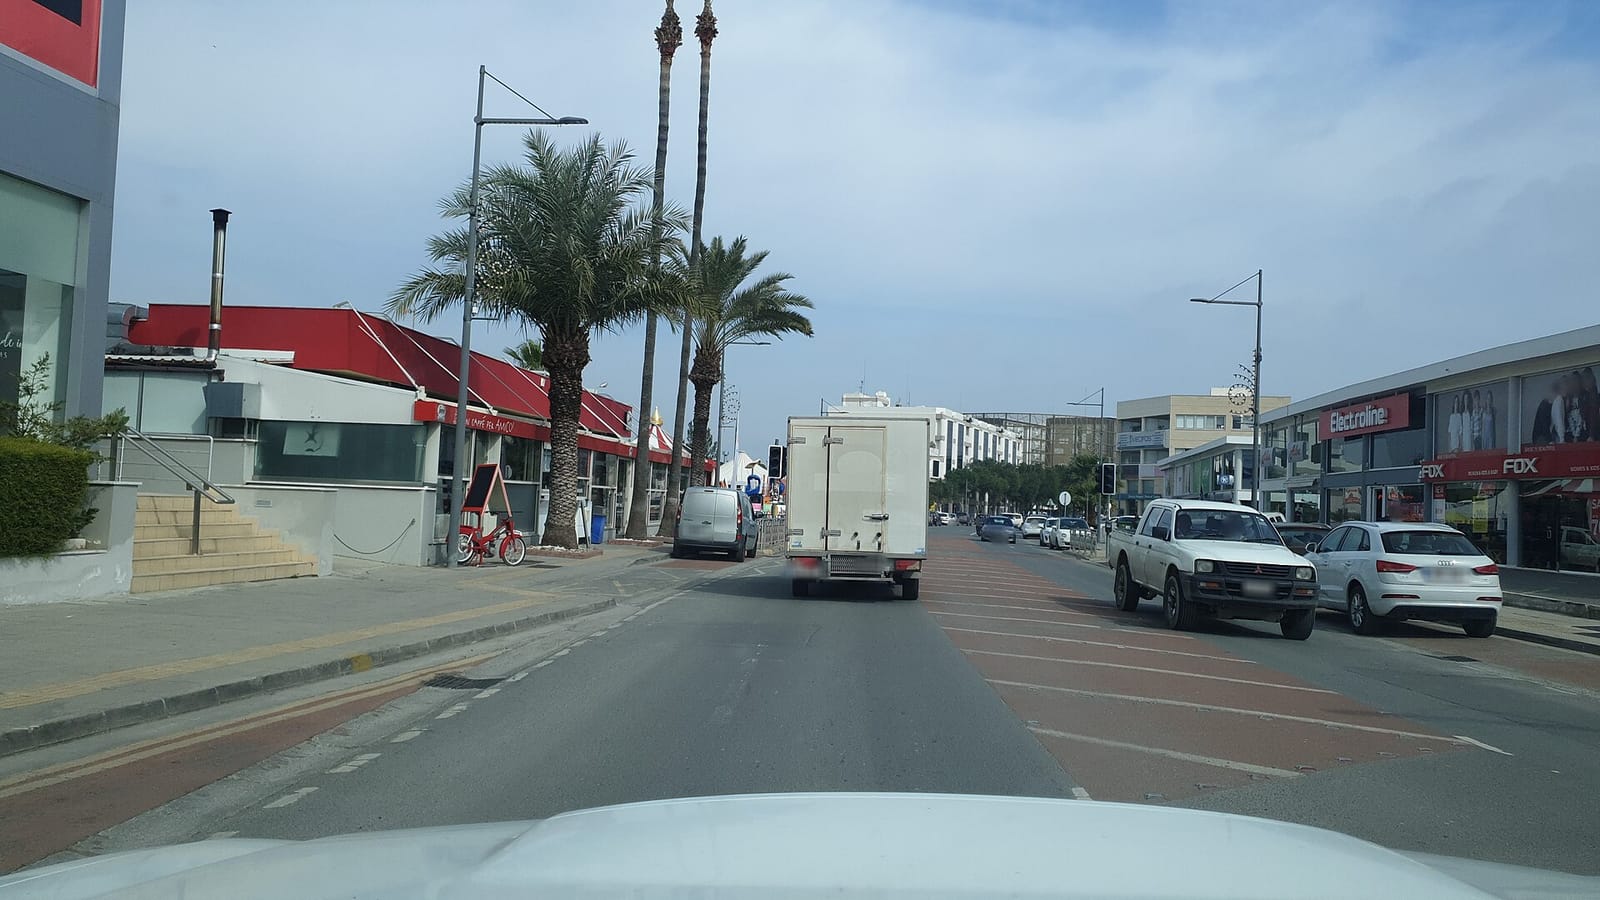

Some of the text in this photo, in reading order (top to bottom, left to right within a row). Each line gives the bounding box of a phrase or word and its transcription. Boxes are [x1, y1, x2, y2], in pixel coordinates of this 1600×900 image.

[1330, 405, 1386, 433] Electroline
[1421, 463, 1445, 478] FOX
[1502, 457, 1539, 474] FOX
